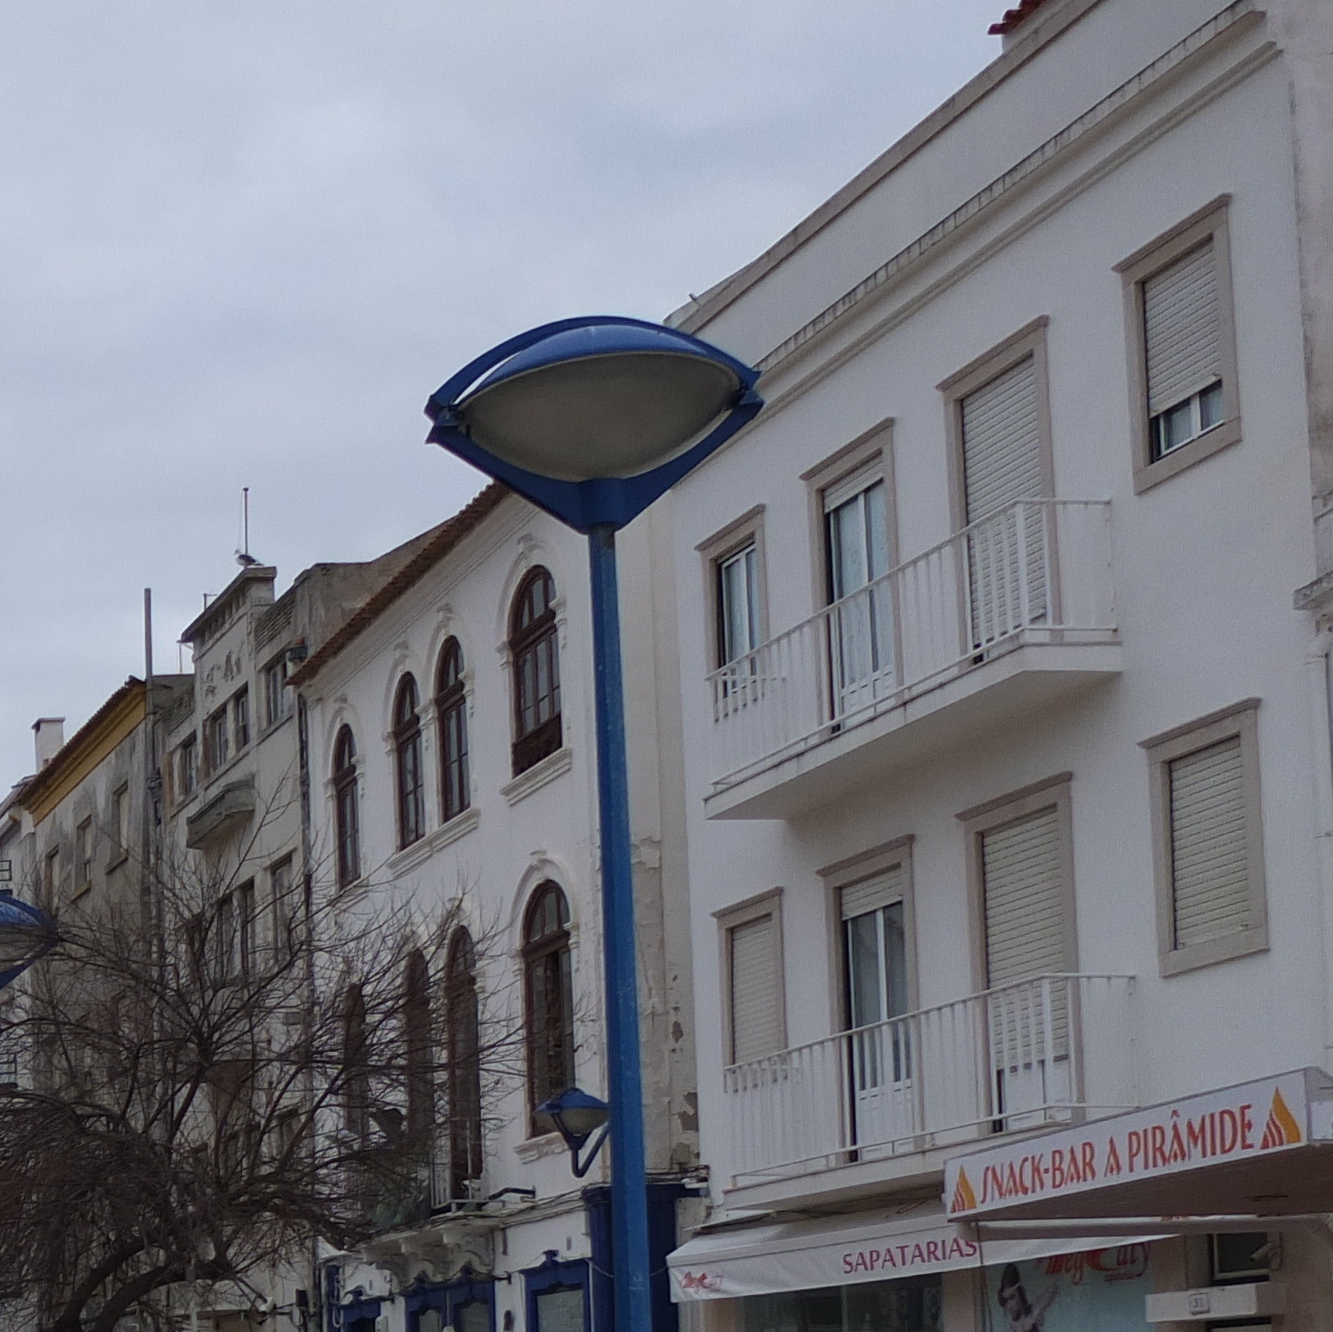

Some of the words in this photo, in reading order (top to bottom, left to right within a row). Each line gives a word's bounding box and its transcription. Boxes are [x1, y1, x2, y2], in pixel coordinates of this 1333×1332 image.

[980, 1140, 1098, 1205] SNACK-BAR
[1104, 1134, 1123, 1178] A
[1127, 1102, 1255, 1174] PIRÂMIDE
[843, 1240, 979, 1275] SAPATARIAS
